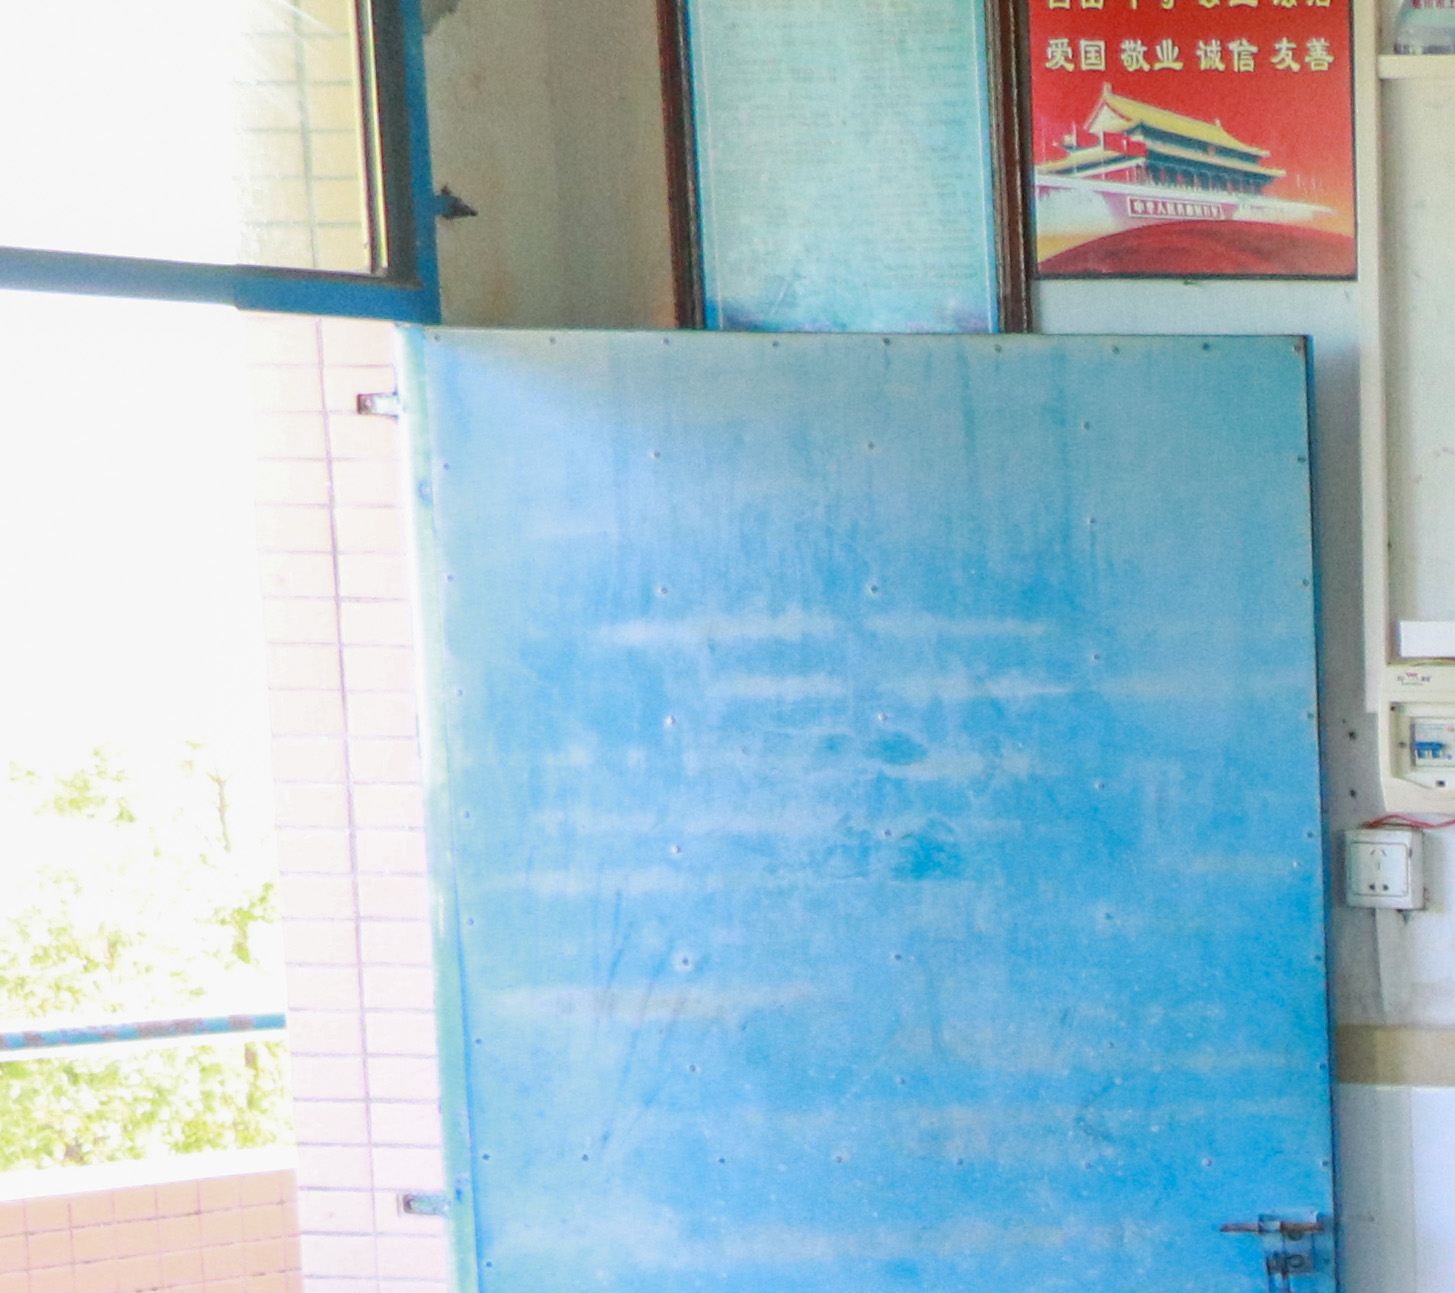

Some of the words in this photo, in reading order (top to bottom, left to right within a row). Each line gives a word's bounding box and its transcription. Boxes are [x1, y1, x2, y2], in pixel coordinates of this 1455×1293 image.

[1045, 38, 1106, 71] 爱国
[1120, 38, 1184, 72] 敬业
[1196, 38, 1259, 73] 诚信
[1271, 37, 1335, 73] 友善
